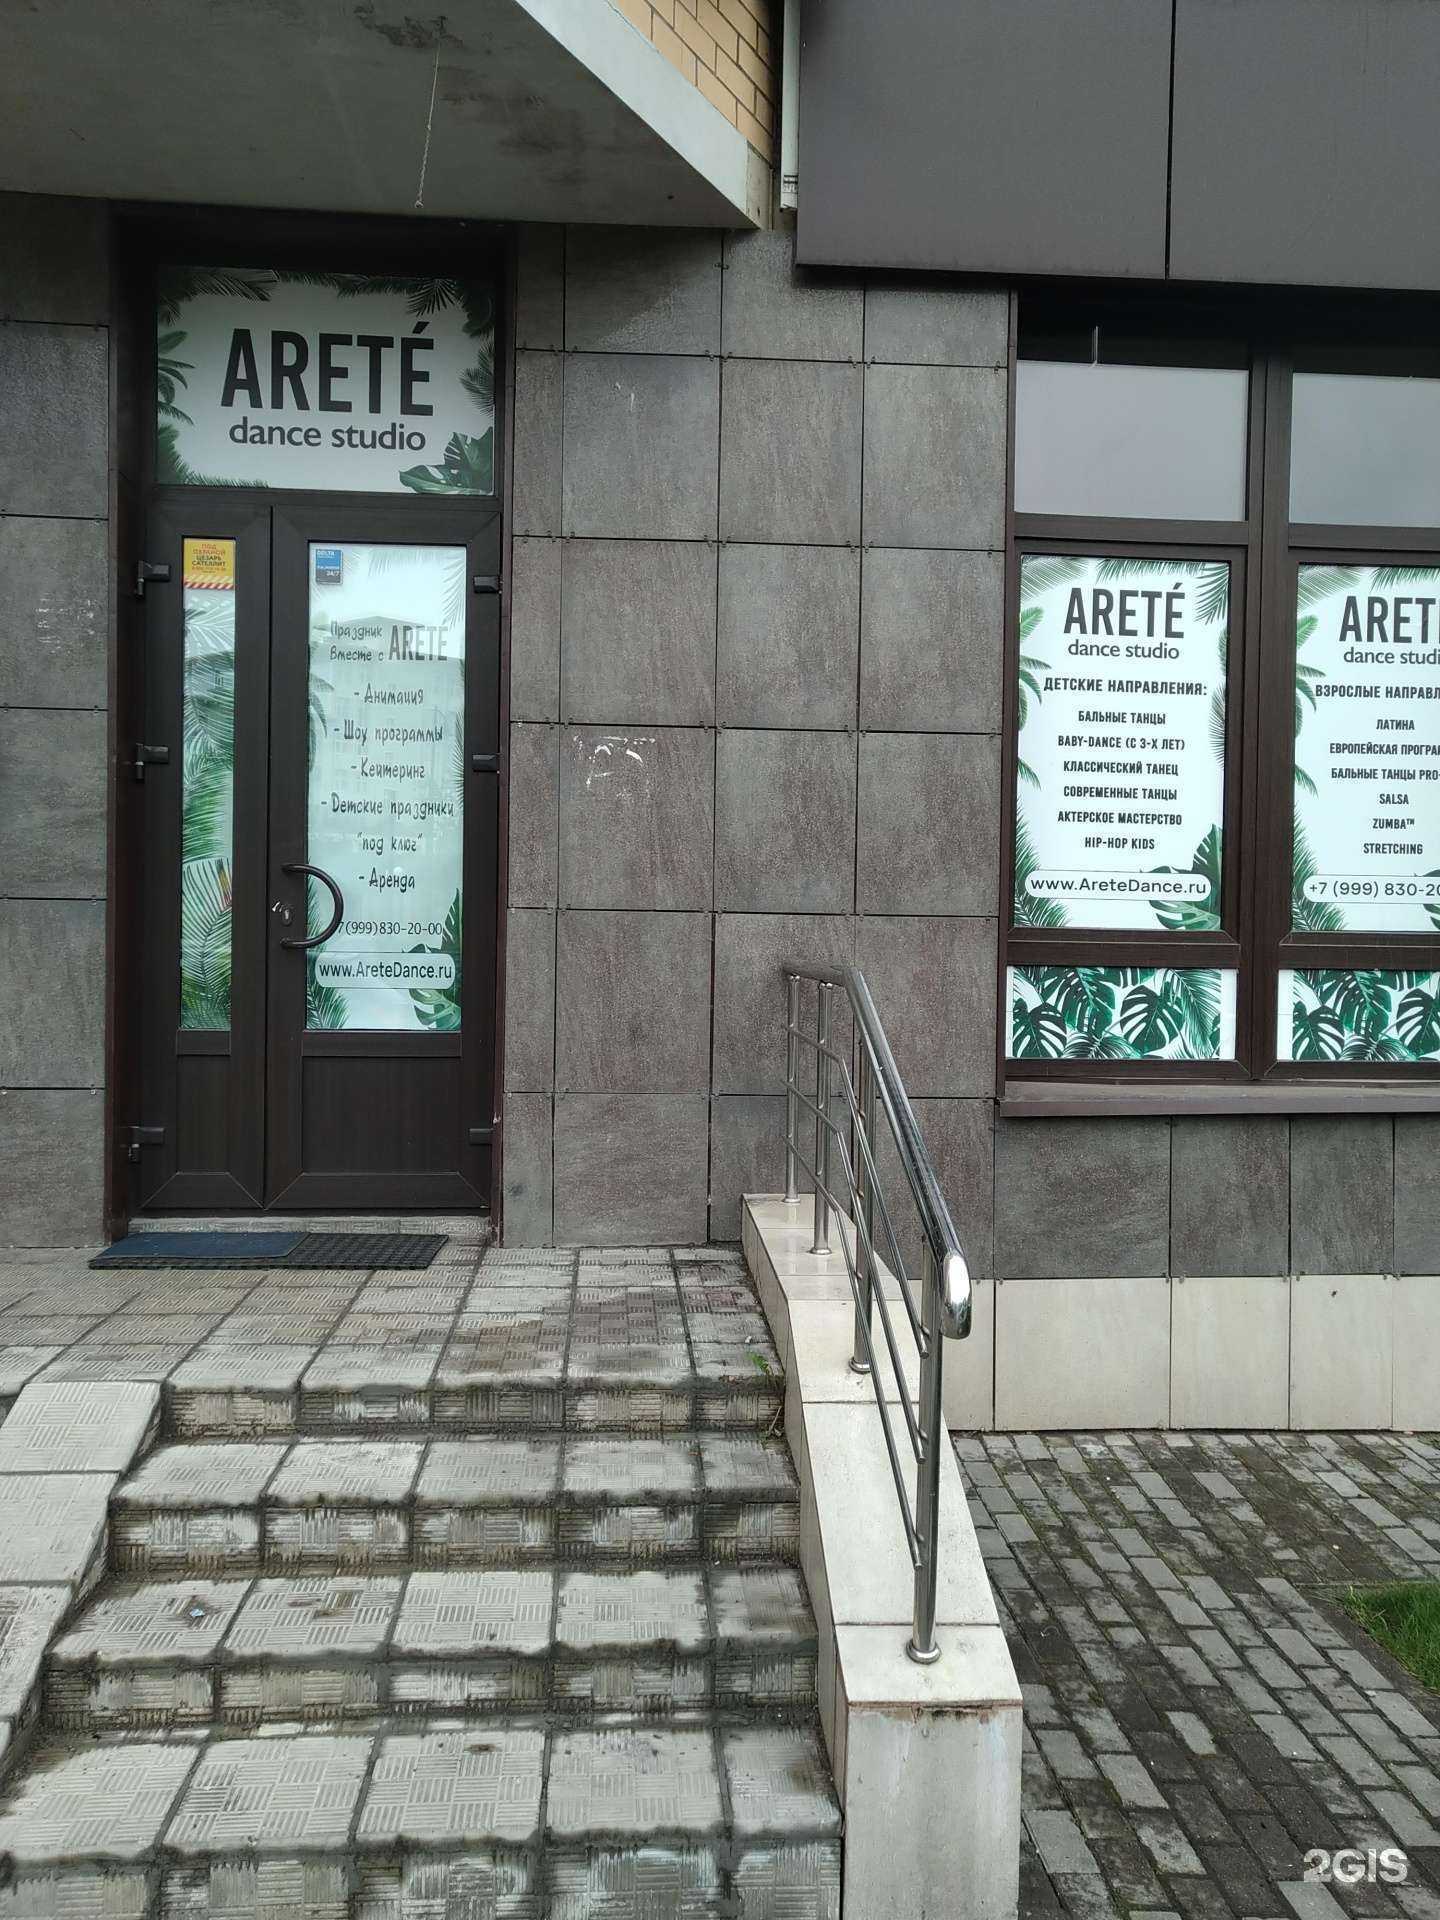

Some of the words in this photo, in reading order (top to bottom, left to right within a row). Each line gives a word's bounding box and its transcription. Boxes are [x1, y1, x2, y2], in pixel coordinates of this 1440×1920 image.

[221, 321, 434, 416] ARETÉ
[229, 416, 321, 447] dance
[331, 422, 426, 450] studio
[1063, 582, 1186, 639] ARETÉ
[1339, 595, 1440, 644] ARET
[330, 621, 382, 640] Праздник
[330, 645, 372, 661] Вместе
[378, 652, 384, 661] с
[1068, 639, 1120, 657] dance
[1125, 643, 1180, 659] studio
[1344, 647, 1395, 664] dance
[364, 682, 424, 705] Анимация
[1044, 677, 1103, 692] ДЕТСКИЕ
[1108, 680, 1207, 696] НАПРАВЛЕНИЯ:
[1315, 684, 1380, 698] ВЗРОСЛЫЕ
[1078, 710, 1127, 723] БАЛЬНЫЕ
[1130, 712, 1166, 725] ТАНЦЫ
[1376, 719, 1415, 731] ЛАТИНА
[344, 719, 368, 746] Шоу
[375, 726, 443, 746] программы
[1057, 735, 1122, 749] BABY-DANCE
[1161, 739, 1185, 751] ЛЕТ)
[1329, 742, 1398, 755] ЕВРОПЕЙСКАЯ
[1401, 744, 1440, 756] ПРОГРА
[1063, 760, 1142, 774] КЛАССИЧЕСКИЙ
[1146, 763, 1178, 776] ТАНЕЦ
[1331, 768, 1378, 780] БАЛЬНЫЕ
[1381, 769, 1416, 781] ТАНЦЫ
[1063, 786, 1138, 799] СОВРЕМЕННЫЕ
[1142, 788, 1177, 801] ТАНЦЫ
[1379, 793, 1409, 805] SALSA
[331, 792, 383, 815] Детские
[390, 800, 454, 820] праздники
[1057, 811, 1114, 824] АКТЕРСКОЕ
[1118, 812, 1182, 825] МАСТЕРСТВО
[1085, 836, 1128, 849] HIP-HOP
[1131, 838, 1155, 850] KIDS
[1363, 843, 1423, 855] STRETCHING
[369, 867, 415, 893] Аренда
[1031, 877, 1206, 894] www.AreteDance.ru
[1309, 882, 1328, 895] +7
[1333, 880, 1379, 898] (999)
[319, 961, 452, 980] www.AreteDance.ru
